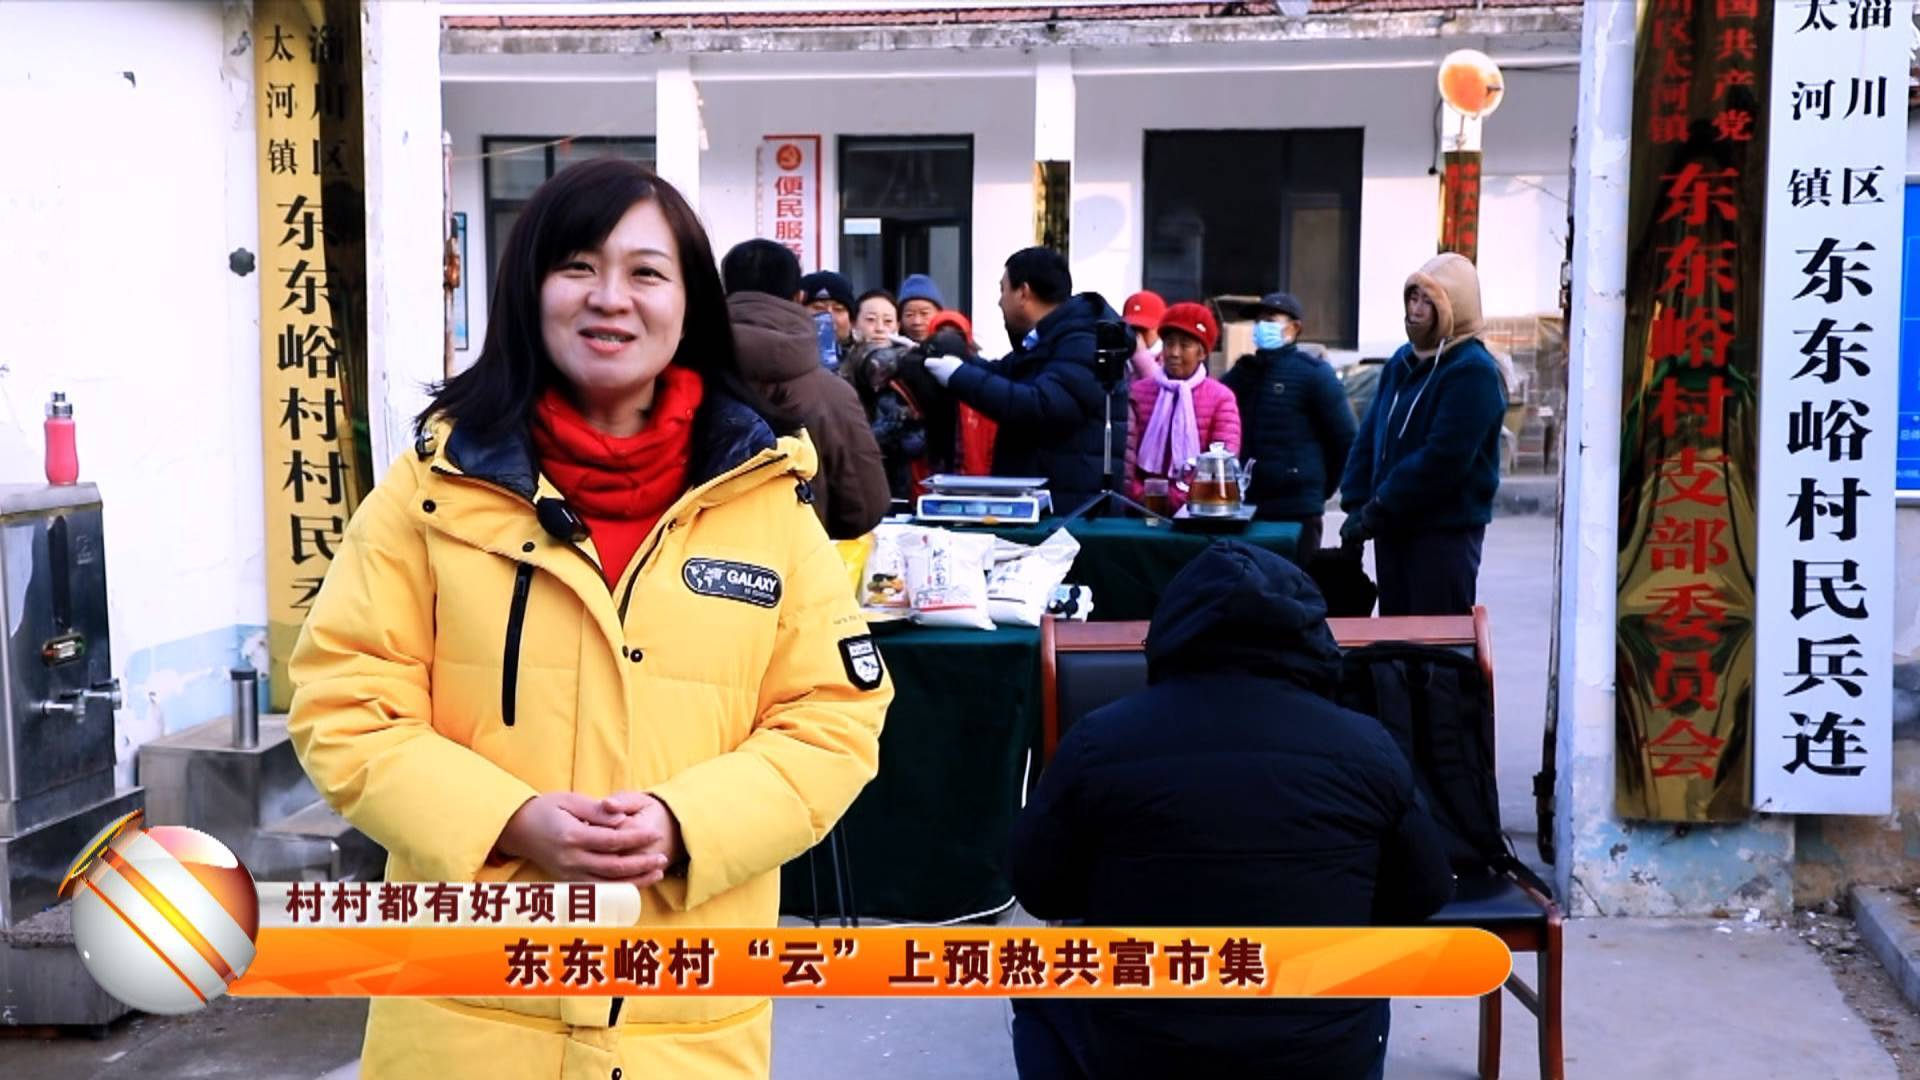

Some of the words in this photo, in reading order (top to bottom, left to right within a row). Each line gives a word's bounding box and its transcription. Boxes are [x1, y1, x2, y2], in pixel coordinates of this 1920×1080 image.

[265, 25, 298, 175] 太河镇
[1787, 0, 1838, 208] 太河镇
[1646, 162, 1740, 779] 东东峪村支部委员会
[1782, 238, 1877, 777] 东东峪村民兵连
[726, 569, 777, 593] GALAXY
